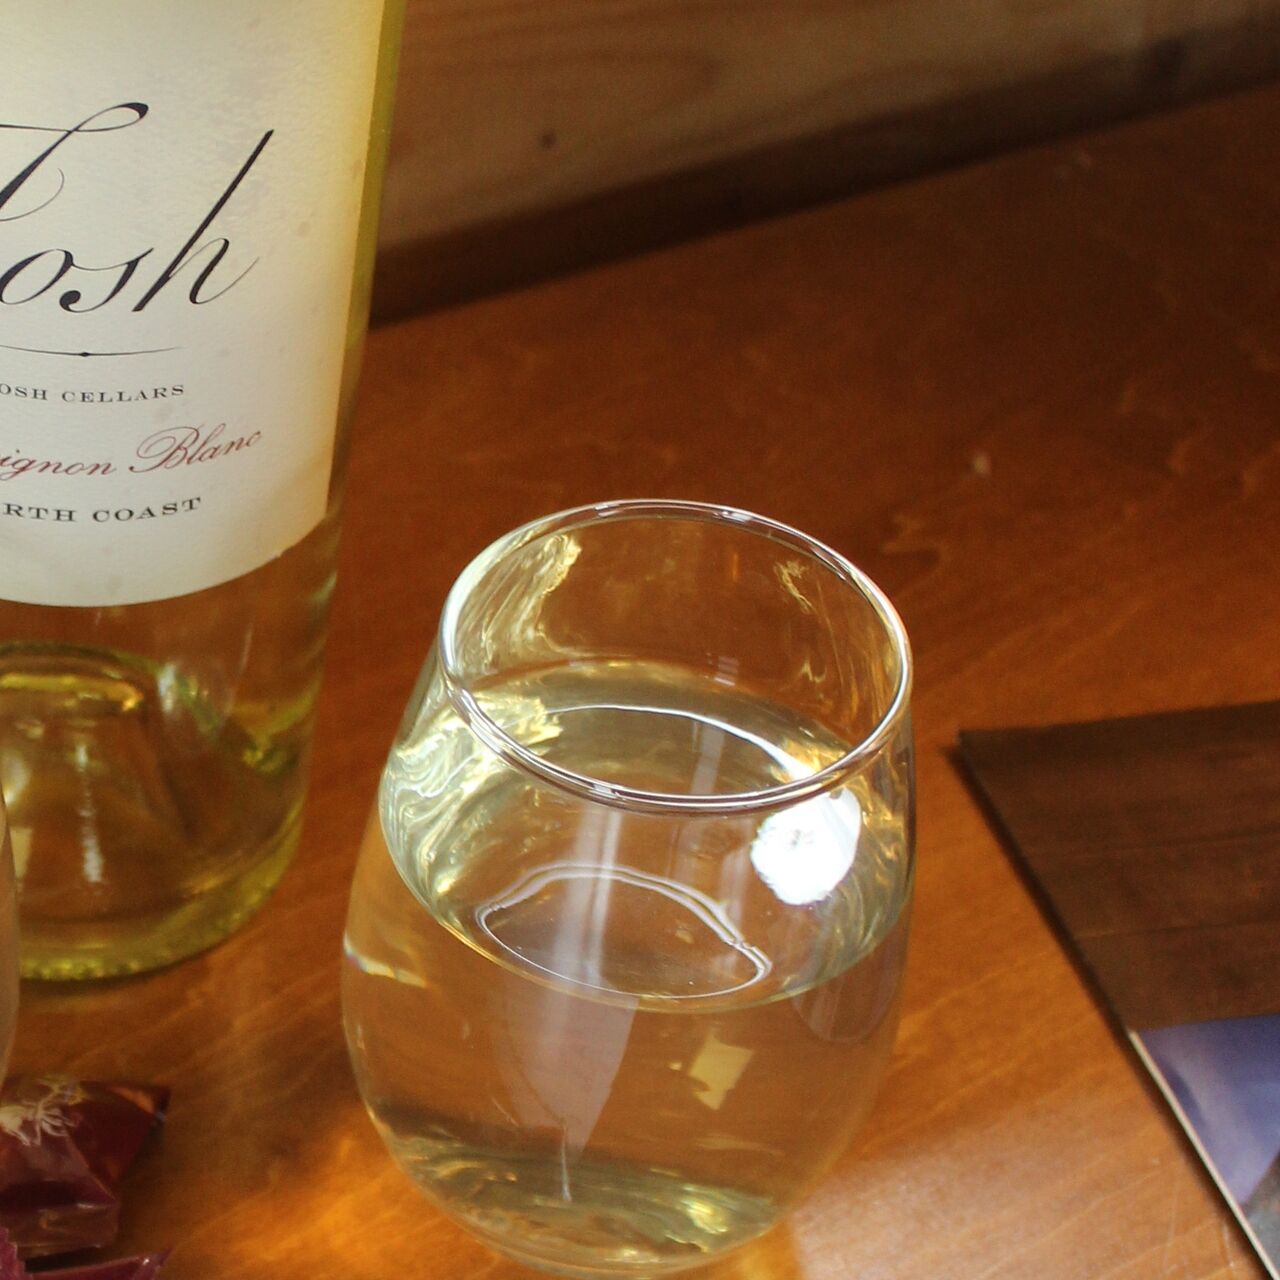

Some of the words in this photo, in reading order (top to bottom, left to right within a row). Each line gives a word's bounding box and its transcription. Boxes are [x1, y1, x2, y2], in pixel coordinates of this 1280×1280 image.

[61, 384, 186, 404] CELLARS
[128, 425, 263, 474] Blanc
[91, 496, 203, 523] COAST
